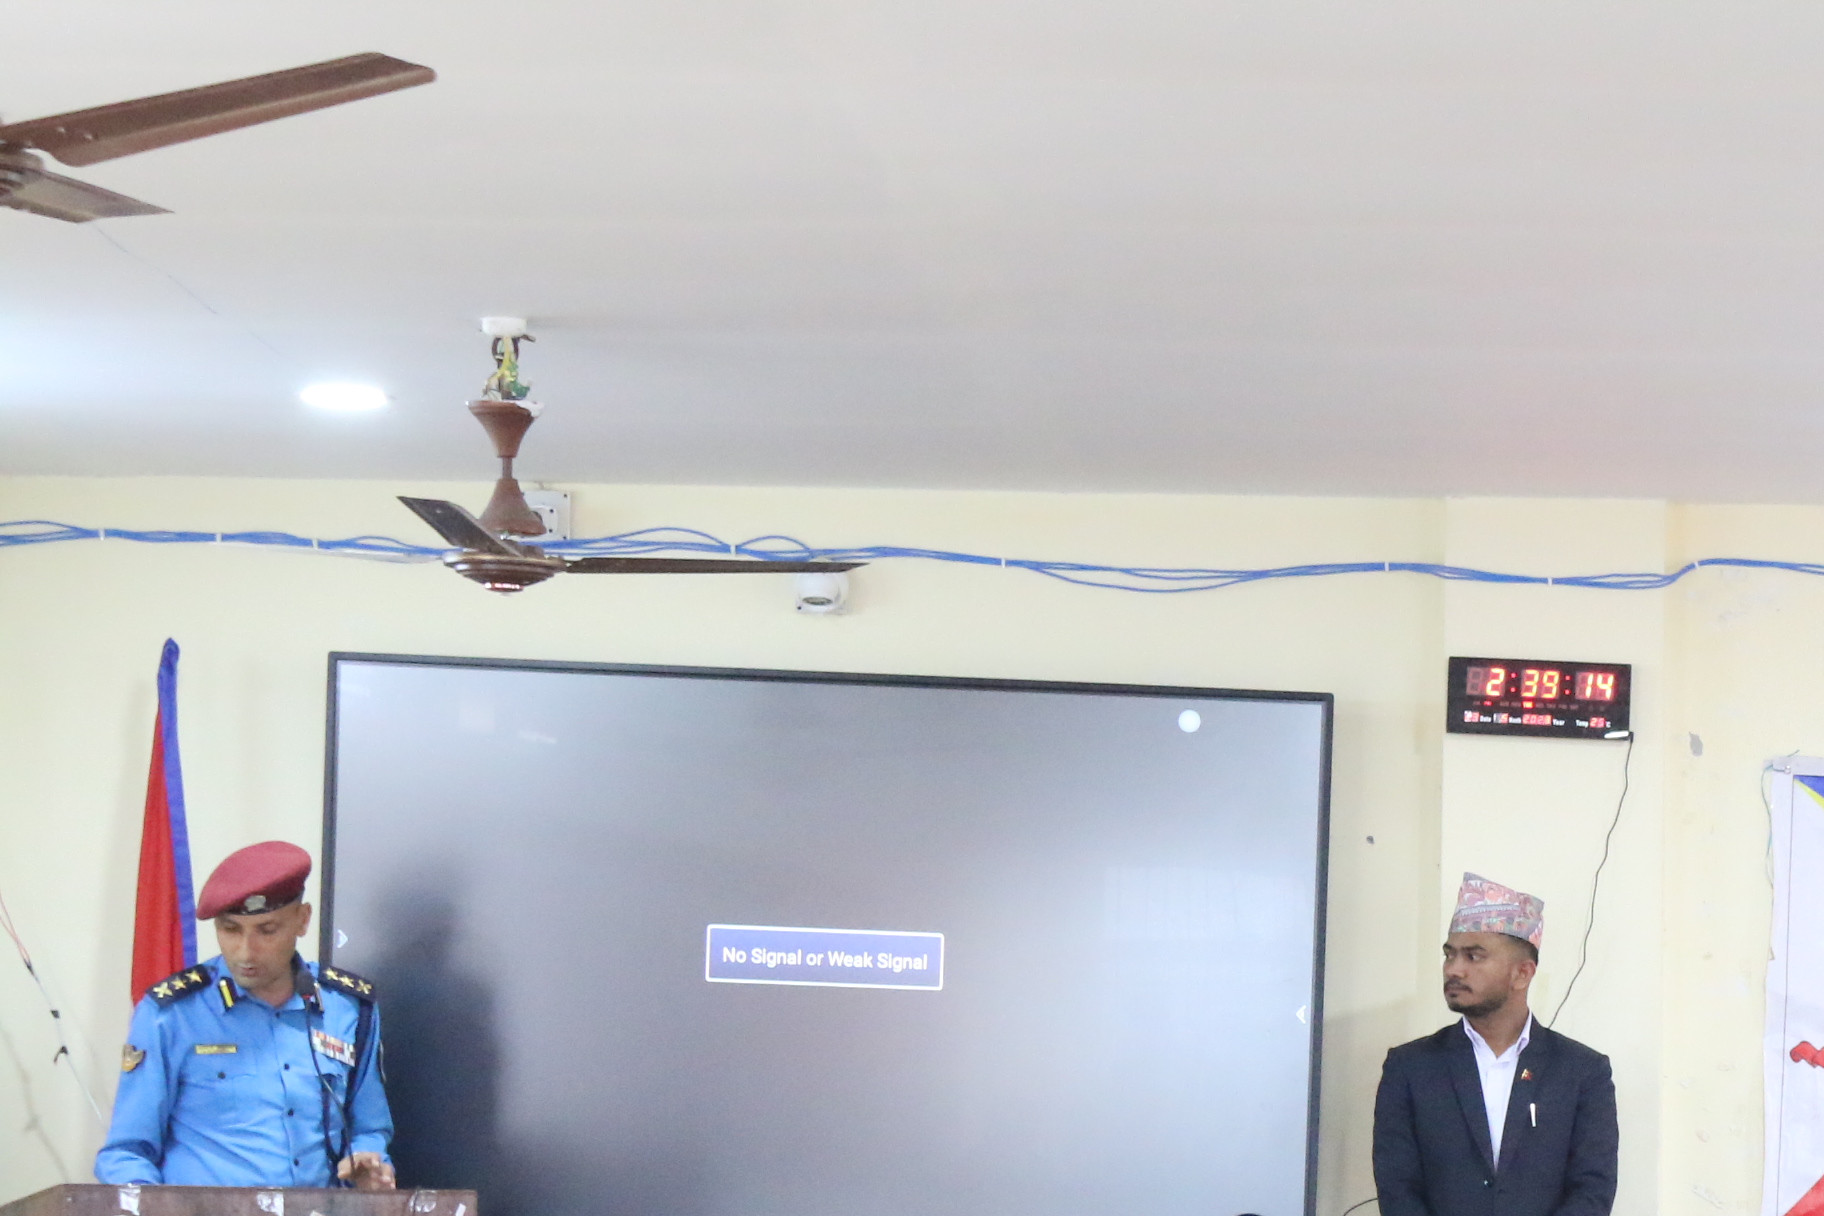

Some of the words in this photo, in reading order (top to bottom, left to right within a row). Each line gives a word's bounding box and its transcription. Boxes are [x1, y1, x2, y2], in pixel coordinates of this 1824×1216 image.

[722, 946, 747, 965] No
[751, 947, 802, 969] Signal
[806, 951, 824, 967] or
[827, 949, 873, 969] Weak
[877, 952, 928, 973] Signal
